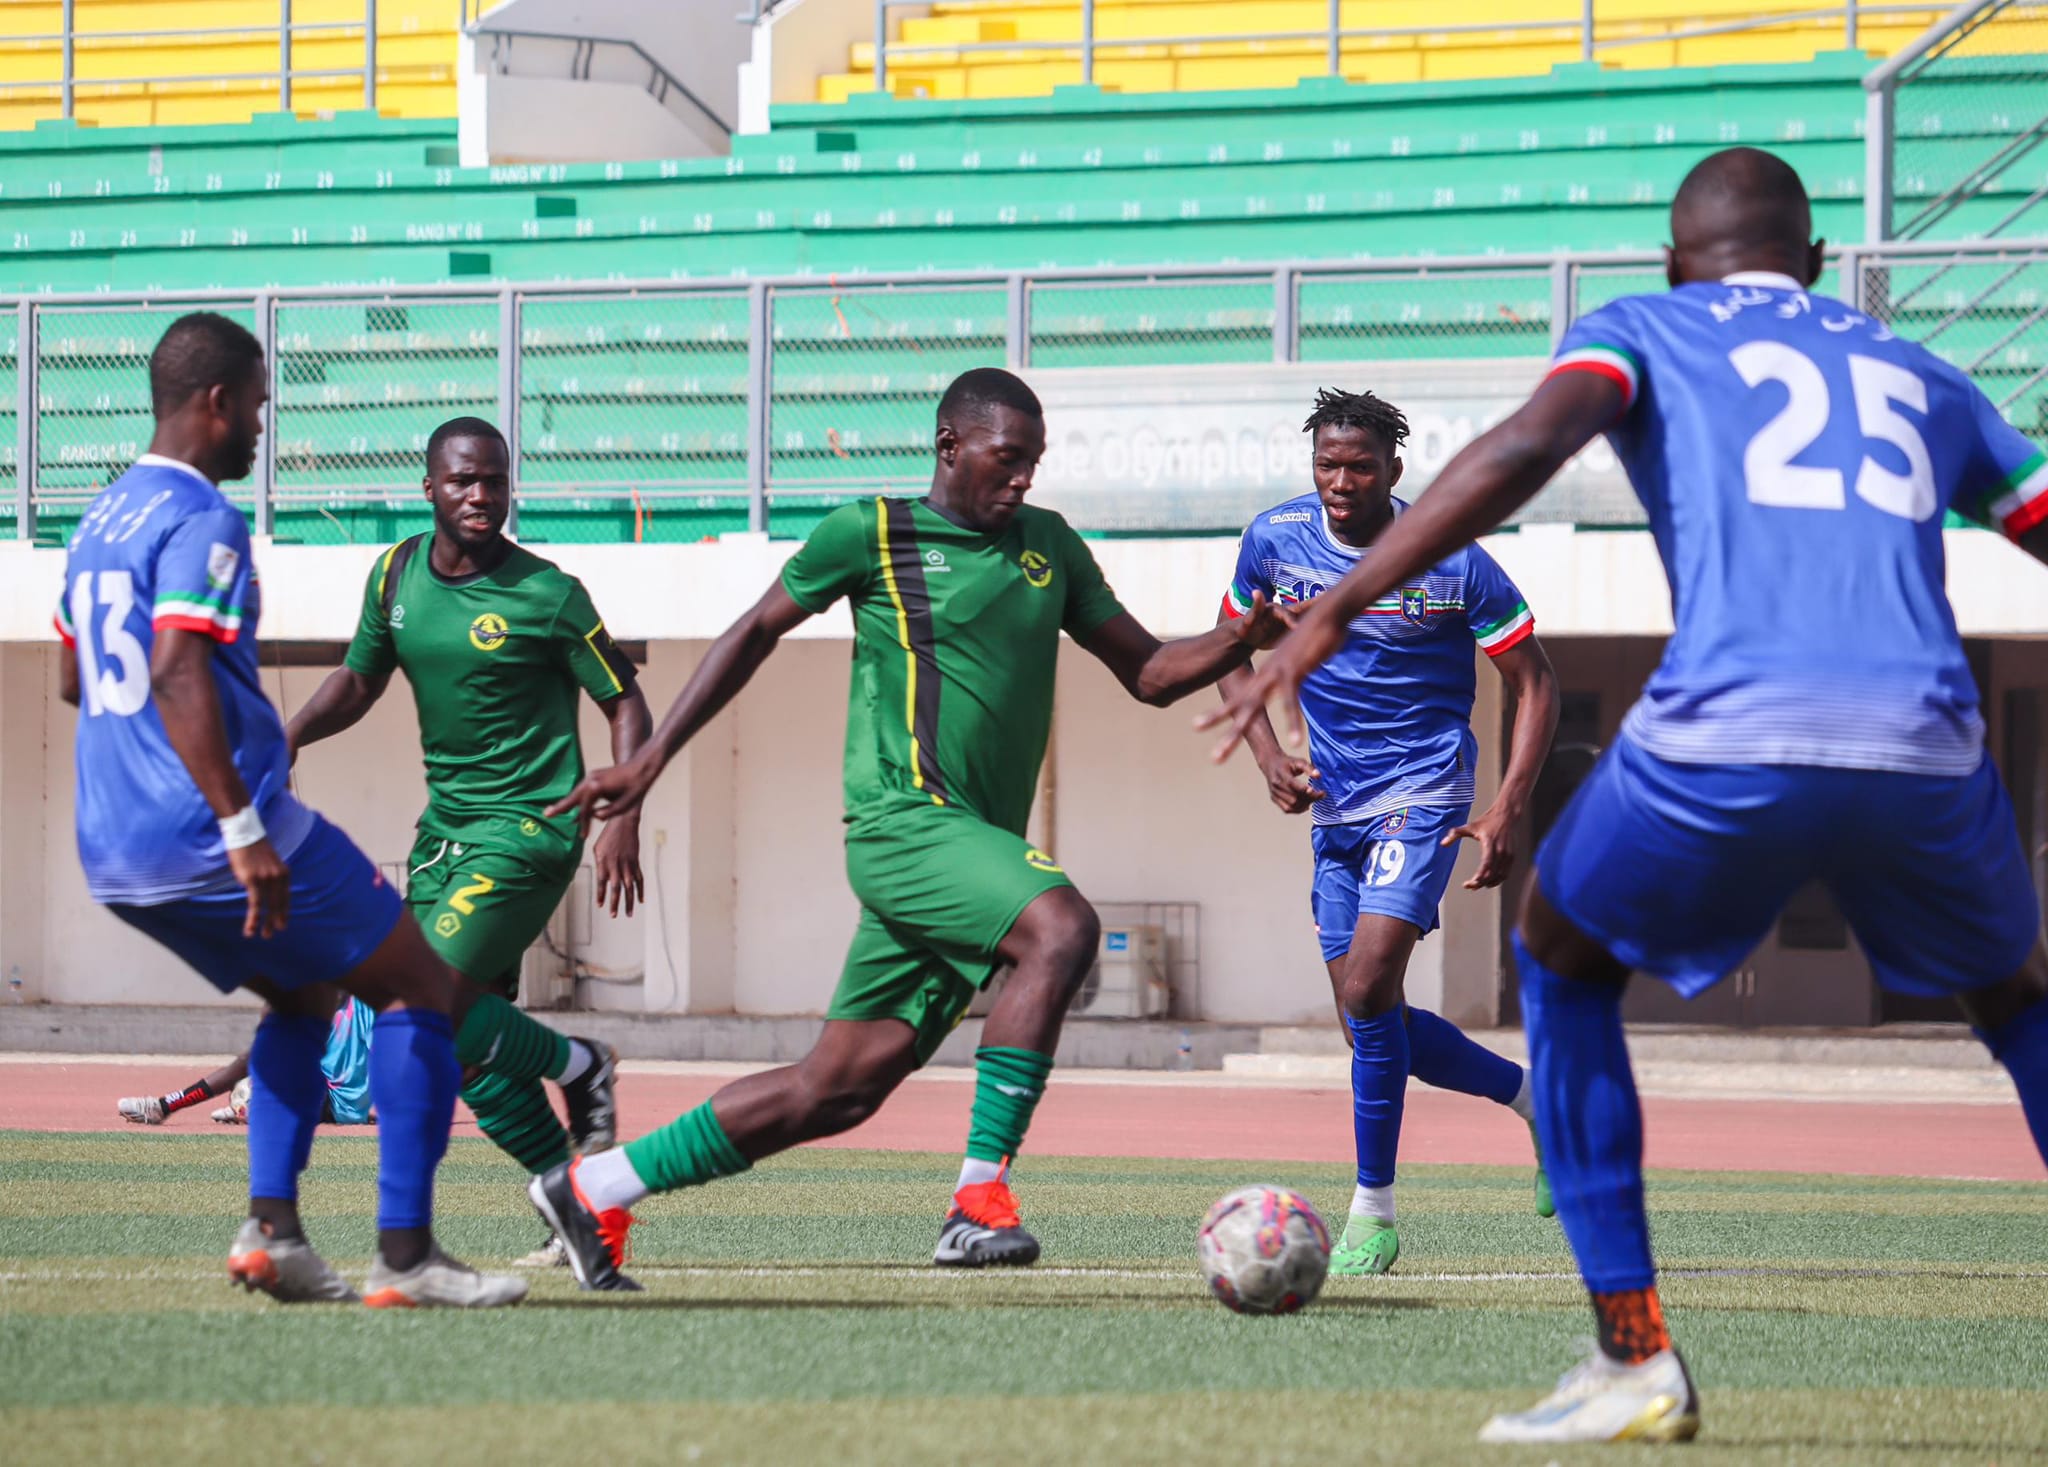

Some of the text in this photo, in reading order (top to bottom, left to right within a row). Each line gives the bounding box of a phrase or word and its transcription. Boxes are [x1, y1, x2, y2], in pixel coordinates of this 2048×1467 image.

[95, 179, 110, 196] 21
[154, 175, 169, 192] 23
[265, 171, 281, 189] 27
[317, 170, 333, 188] 29
[376, 169, 393, 187] 31
[490, 167, 528, 184] RANG
[725, 157, 744, 175] 54
[777, 154, 796, 174] 52
[14, 232, 29, 249] 21
[70, 229, 85, 247] 23
[180, 228, 196, 247] 27
[292, 226, 307, 244] 31
[406, 223, 445, 241] RANG
[60, 444, 100, 461] RANG
[119, 442, 136, 457] 02
[1728, 340, 1938, 524] 25
[70, 570, 151, 717] 13
[1365, 839, 1406, 886] 19
[447, 873, 495, 916] 2
